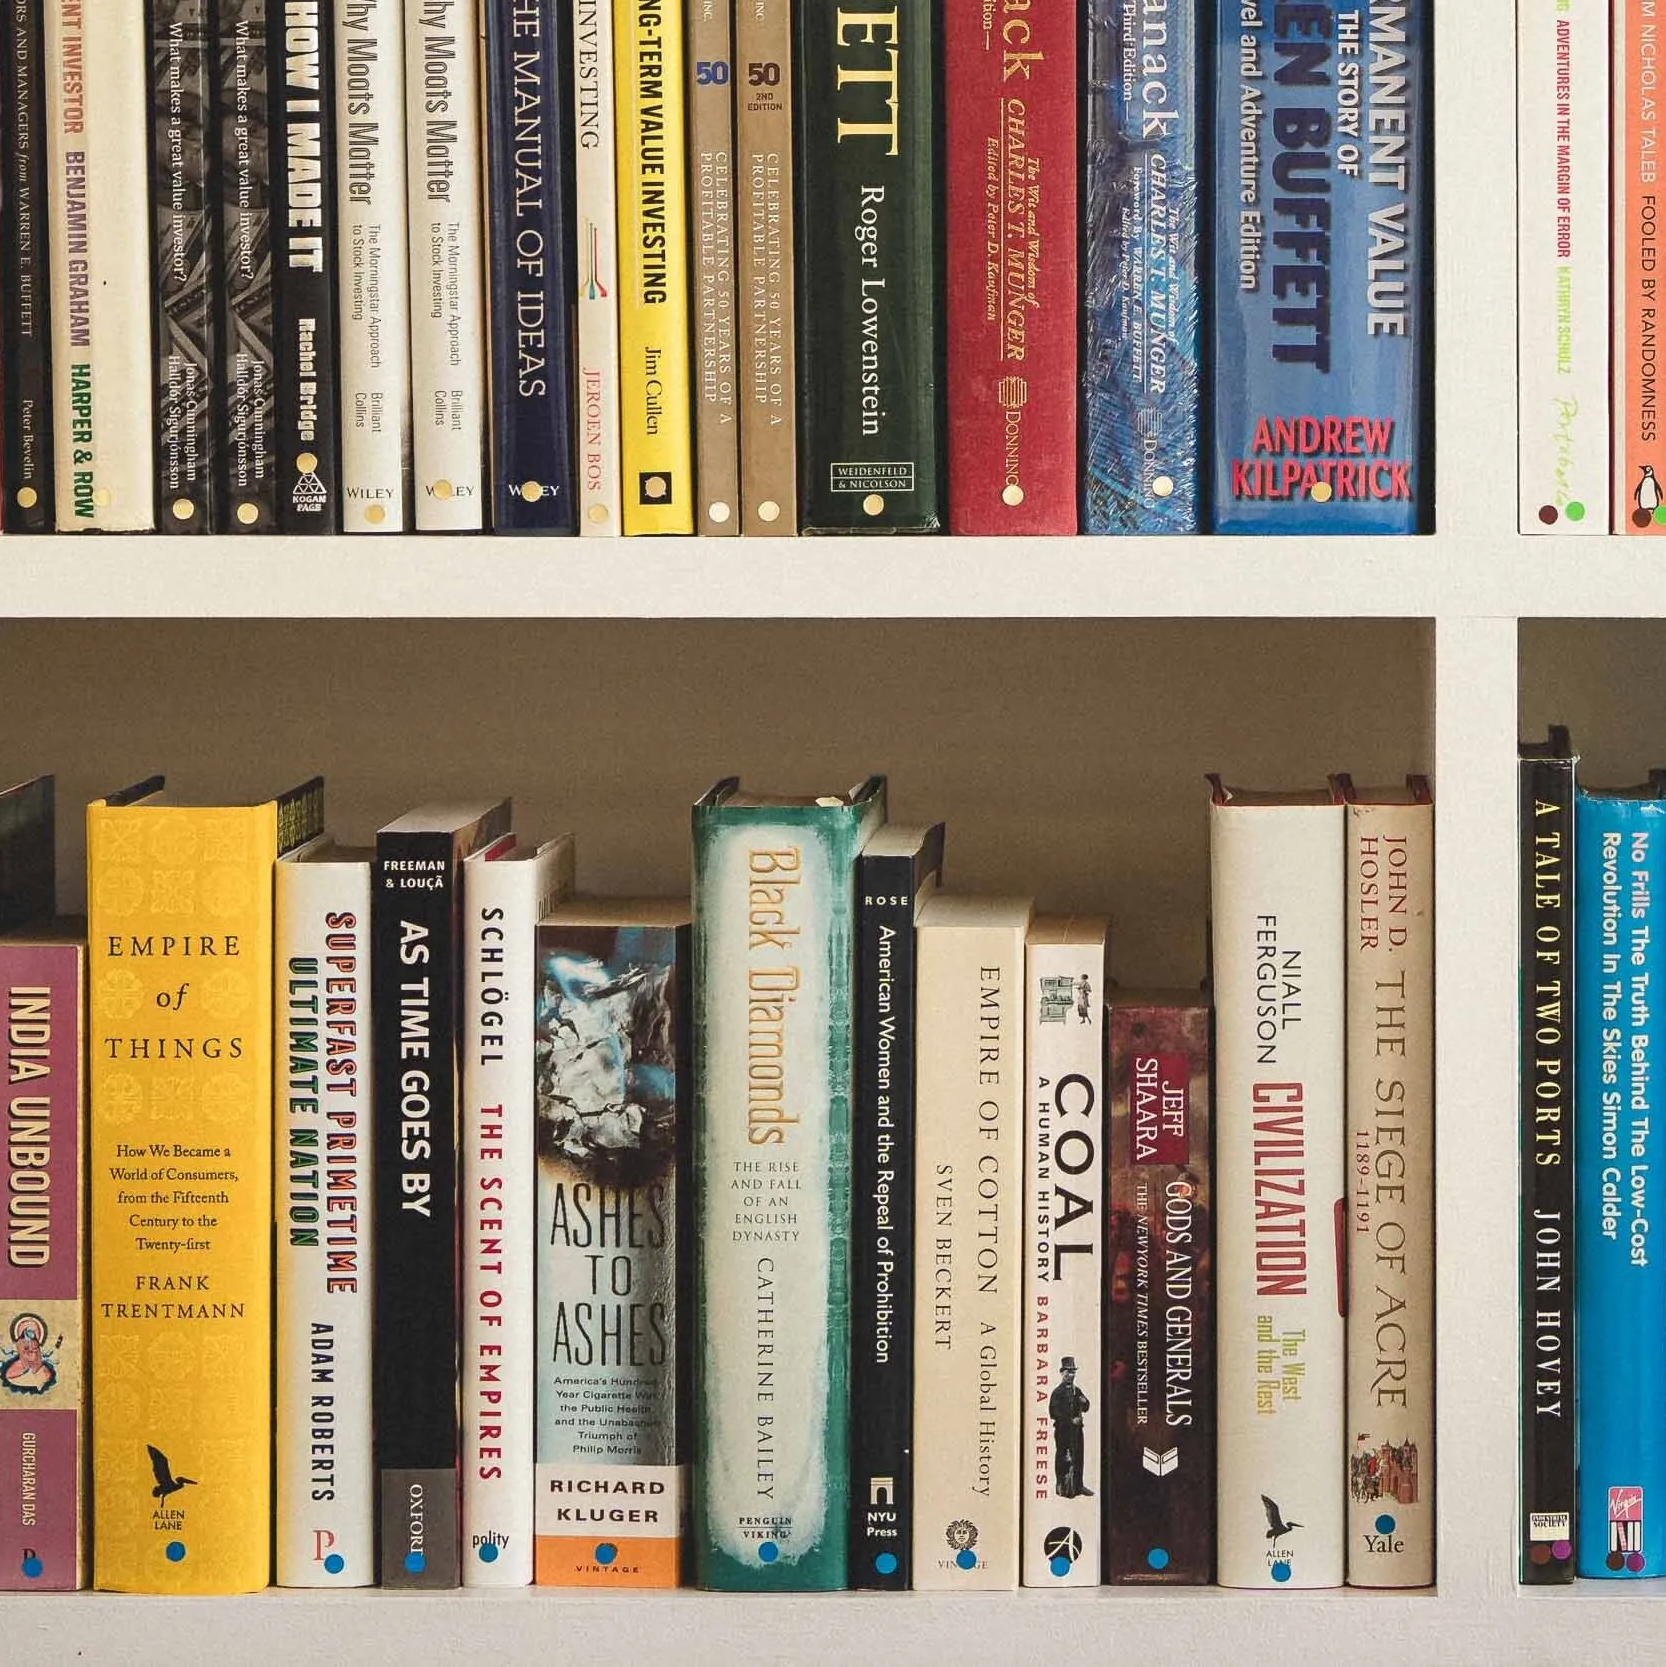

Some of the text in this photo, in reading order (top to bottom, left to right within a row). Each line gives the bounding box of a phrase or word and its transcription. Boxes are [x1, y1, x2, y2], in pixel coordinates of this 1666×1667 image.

[346, 38, 378, 116] Moats
[749, 63, 780, 86] 50
[756, 92, 773, 101] 2ND
[513, 51, 543, 216] MANUAL
[348, 122, 379, 205] Matter
[516, 230, 544, 278] OF
[855, 186, 886, 435] Roger Lowenstein
[517, 290, 546, 397] IDEAS
[1252, 416, 1394, 458] ANDREW
[865, 896, 907, 905] ROSE
[108, 936, 239, 956] EMPIRE
[156, 983, 189, 1010] of
[105, 1038, 241, 1058] THINGS
[400, 920, 431, 1218] AS TIME GOES BY
[1053, 1074, 1094, 1280] COAL
[1253, 1083, 1307, 1295] CIVILIZATION
[135, 1237, 210, 1254] Twenty-first
[551, 1480, 664, 1494] RICHARD
[558, 1509, 657, 1522] KLUGER
[868, 1512, 896, 1524] NYU
[1363, 1534, 1406, 1556] Yale
